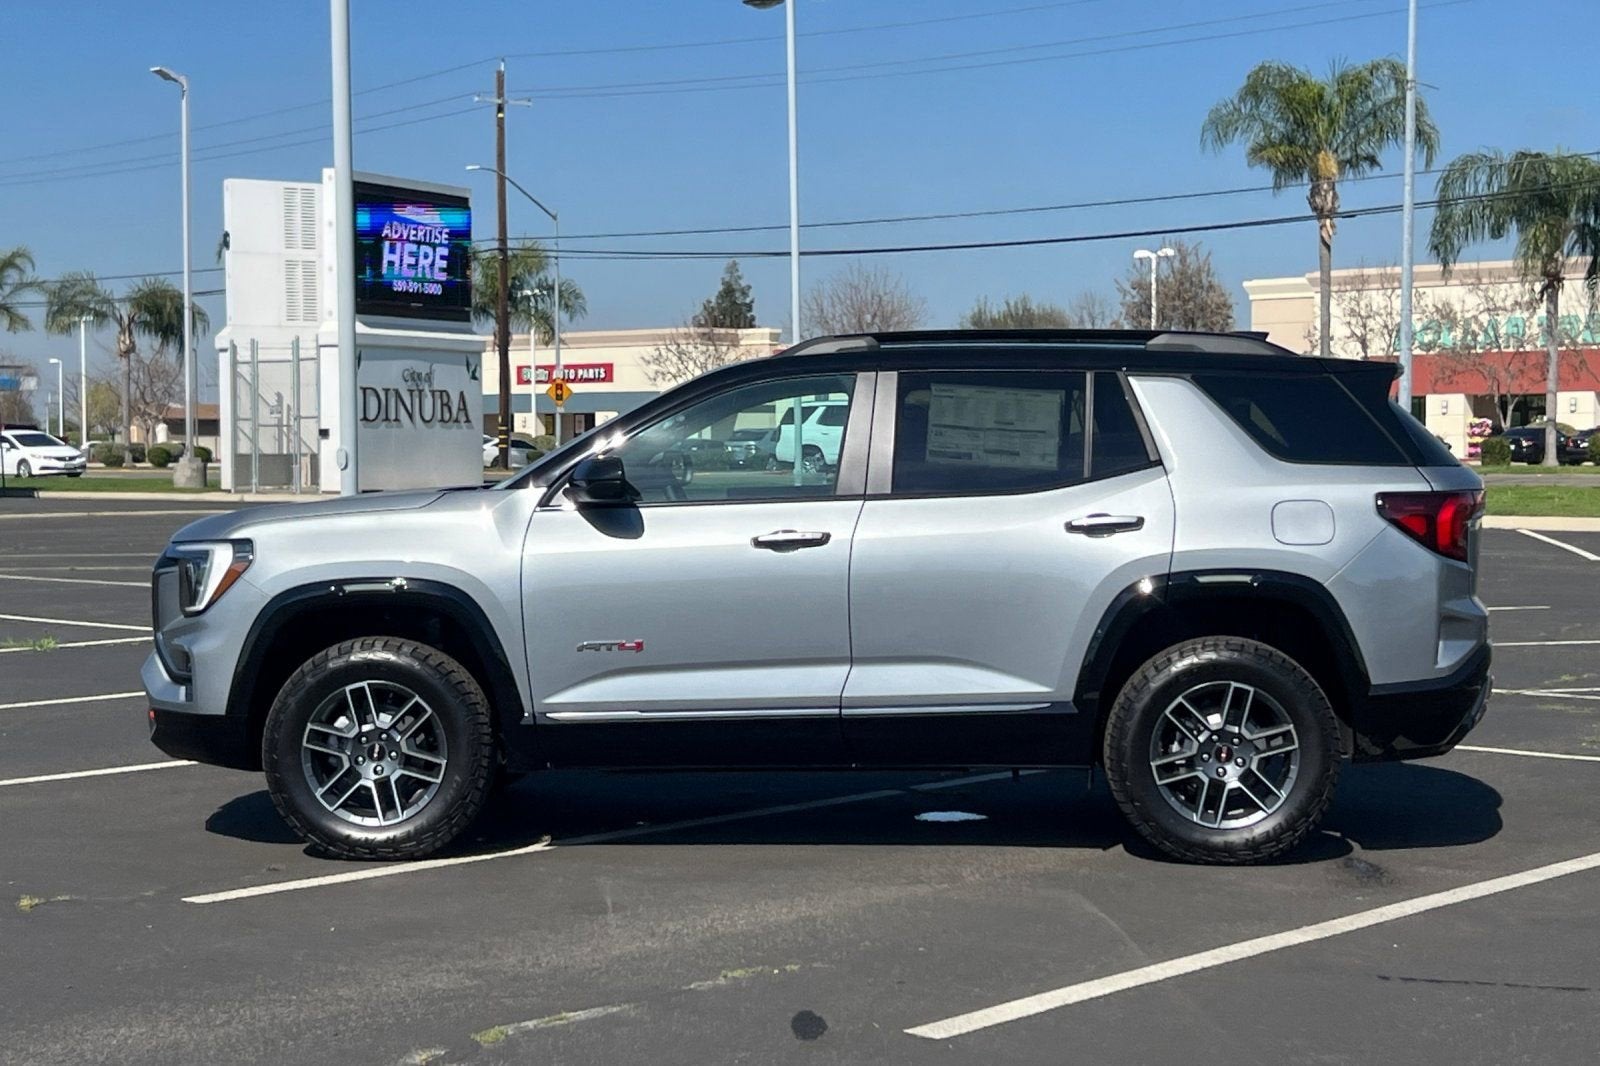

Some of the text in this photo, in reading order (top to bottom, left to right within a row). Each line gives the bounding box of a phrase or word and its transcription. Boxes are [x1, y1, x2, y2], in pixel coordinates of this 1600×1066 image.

[381, 220, 450, 244] ADVERTISE
[381, 240, 449, 280] HERE
[578, 366, 607, 380] PARTS
[360, 386, 473, 425] DINUBA
[576, 639, 645, 653] AT4
